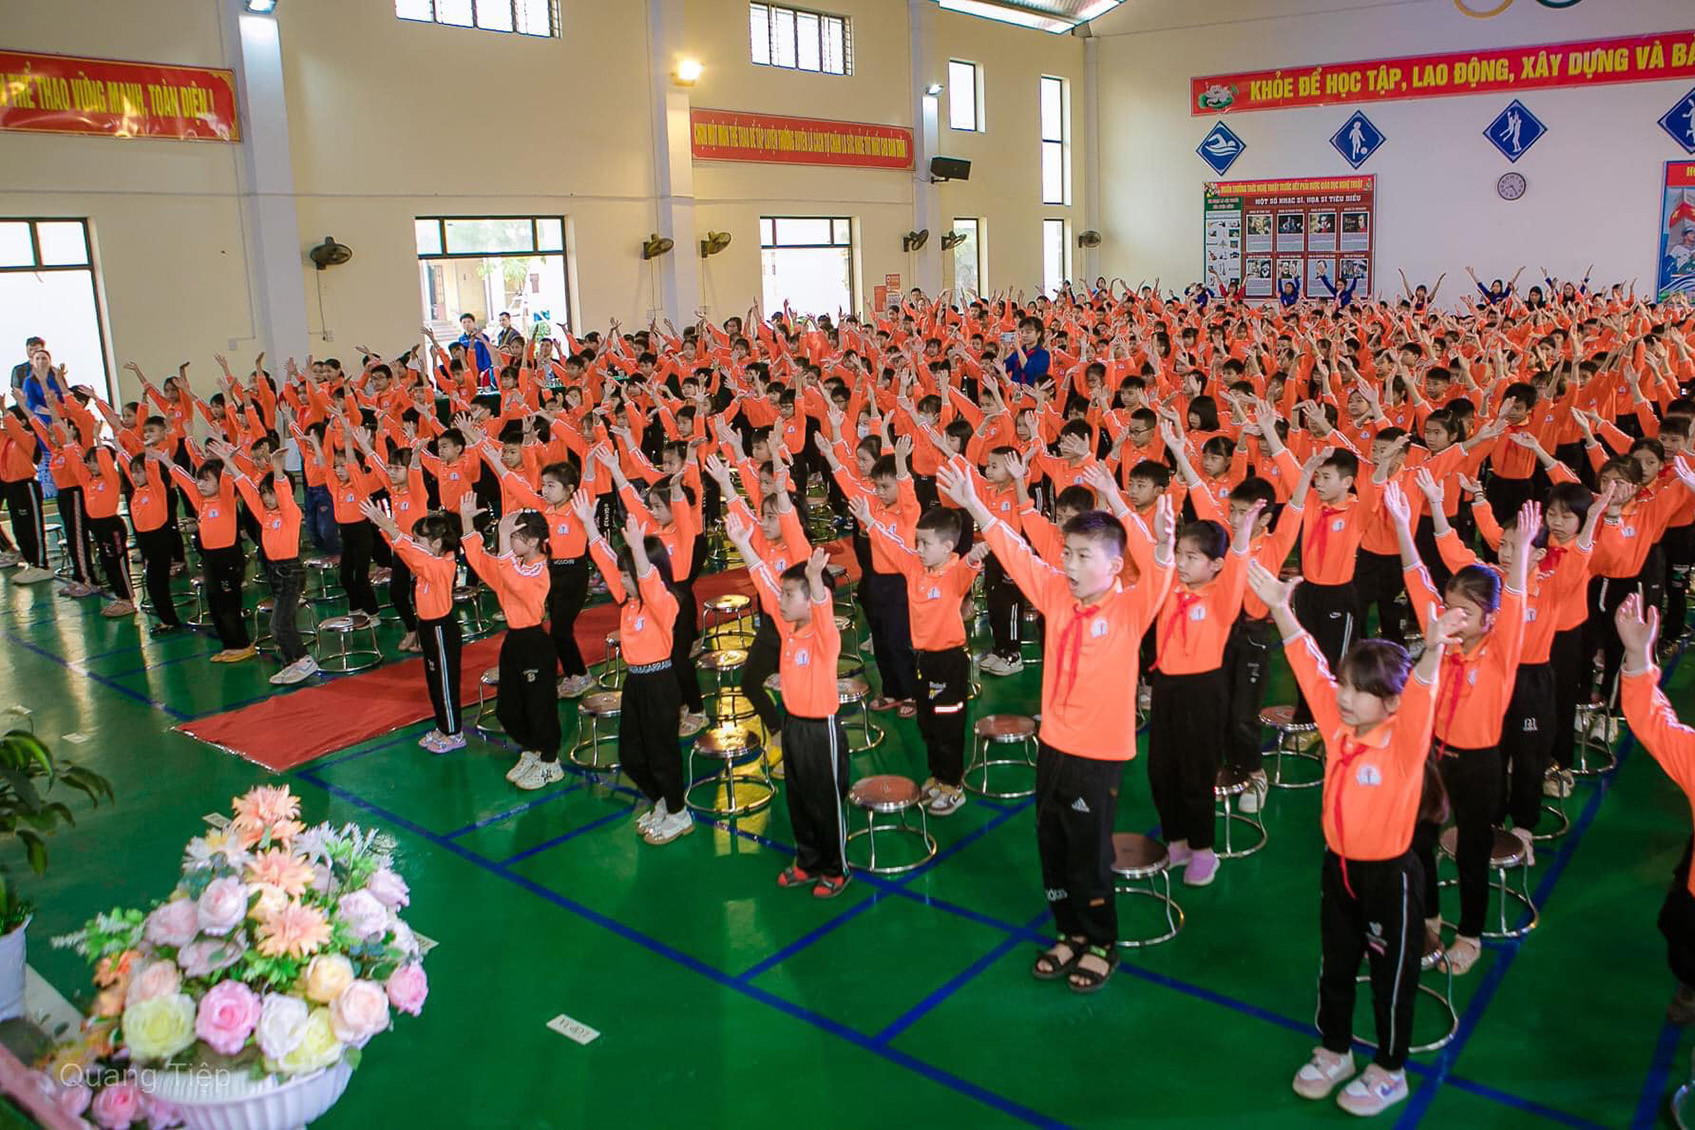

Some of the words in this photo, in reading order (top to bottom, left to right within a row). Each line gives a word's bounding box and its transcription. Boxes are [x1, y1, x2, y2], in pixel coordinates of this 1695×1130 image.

[1250, 70, 1294, 101] KHỎE
[1298, 63, 1323, 97] ĐỂ
[1326, 71, 1362, 98] HỌC
[1367, 64, 1407, 94] TẬP,
[1412, 64, 1448, 88] LAO
[1453, 57, 1515, 87] ĐỘNG,
[1520, 50, 1563, 79] XÂY
[1567, 47, 1629, 79] DỰNG
[1635, 40, 1665, 70] VÀ
